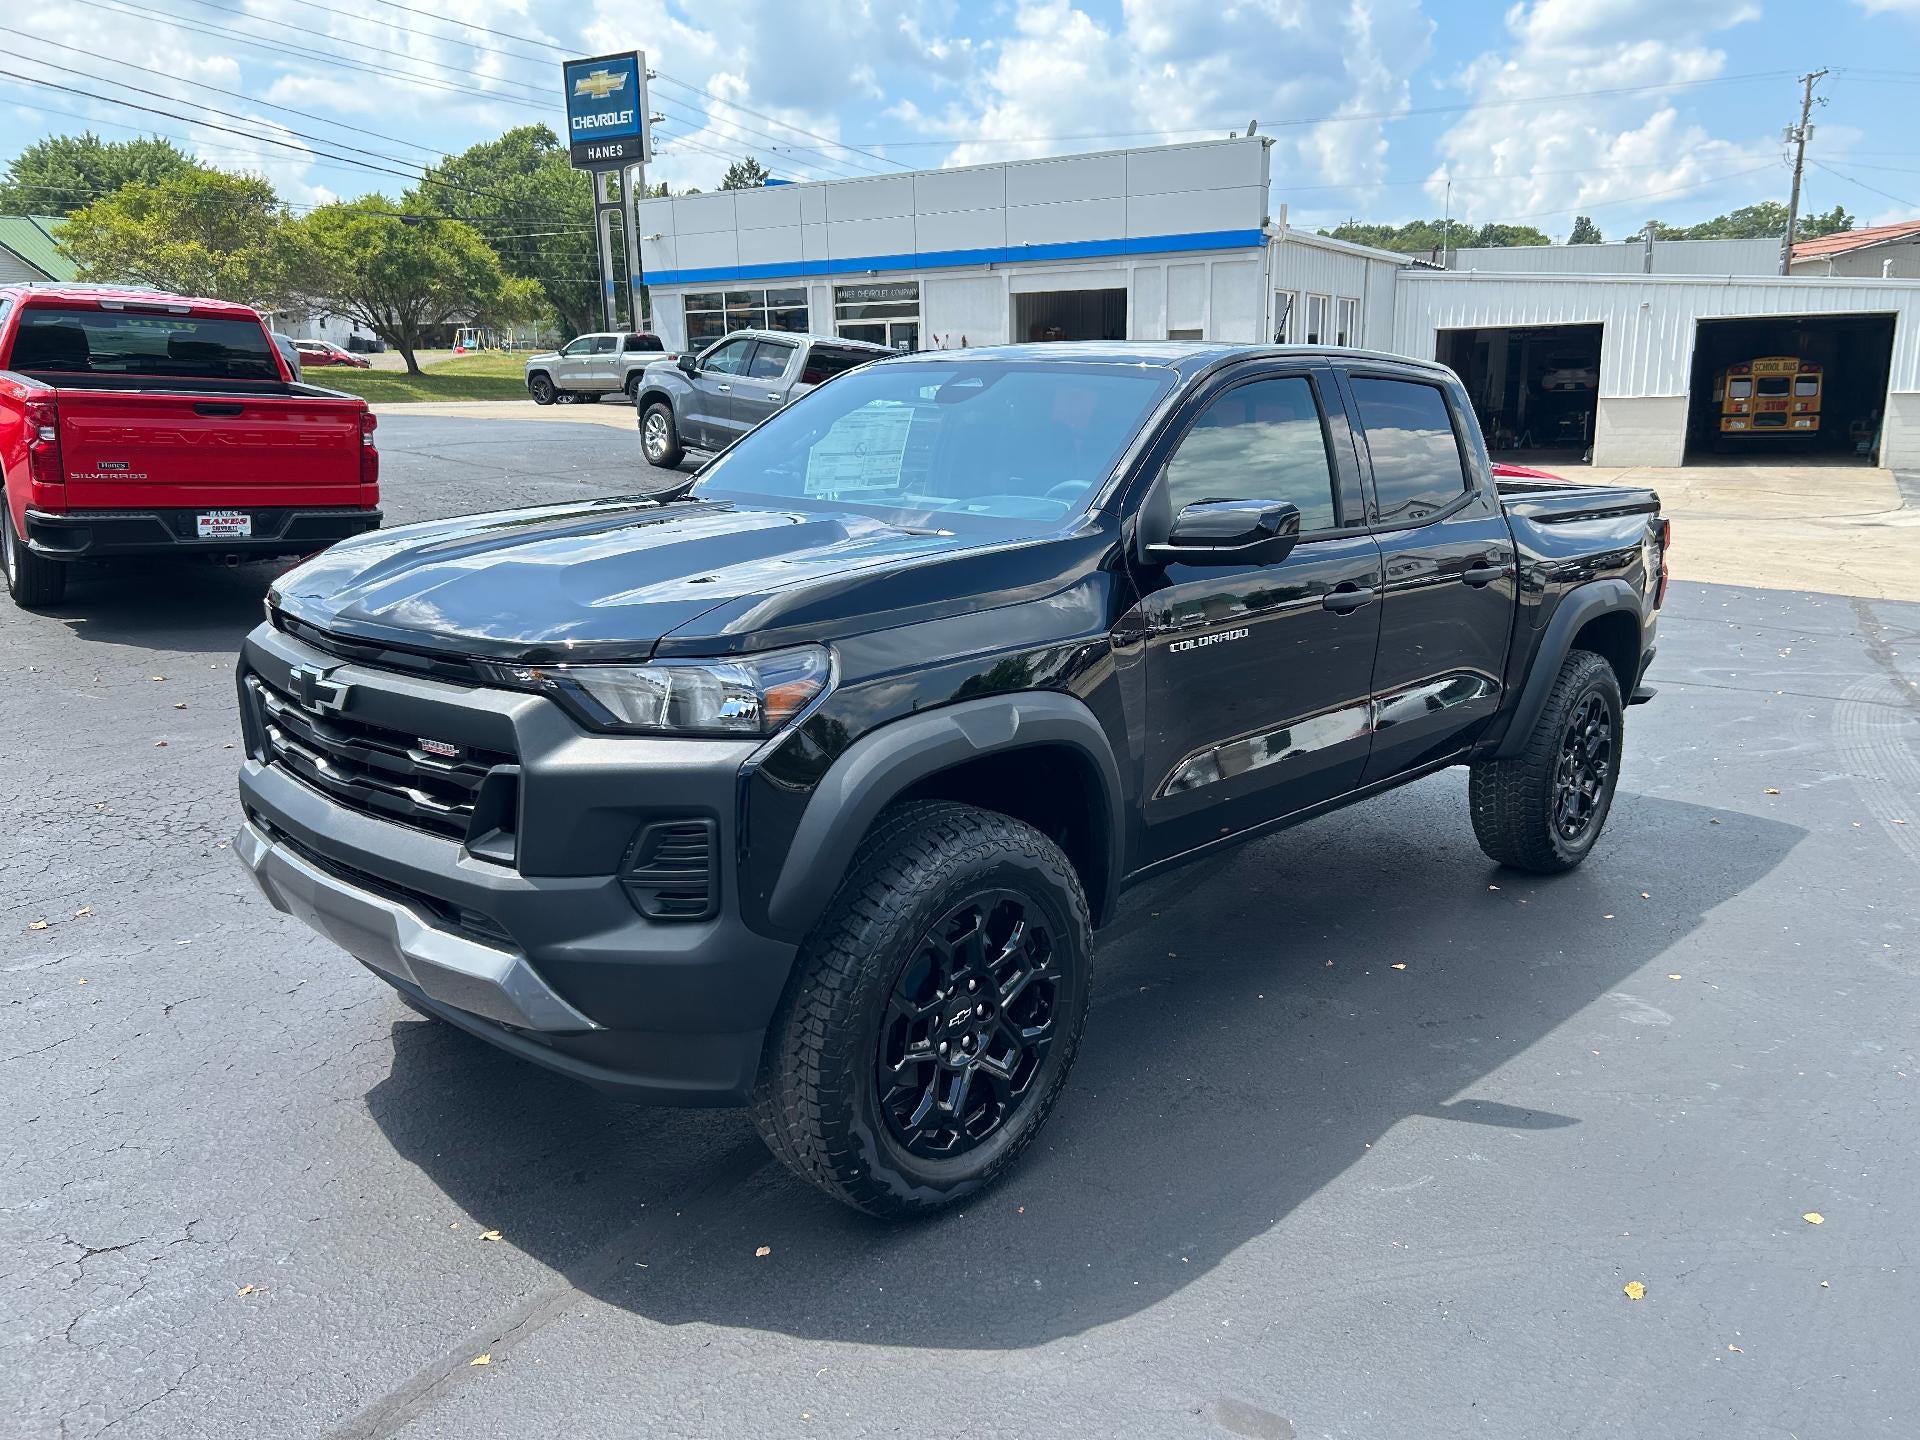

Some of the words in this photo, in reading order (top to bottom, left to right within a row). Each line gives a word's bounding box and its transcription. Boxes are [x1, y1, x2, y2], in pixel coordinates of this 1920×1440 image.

[572, 110, 634, 130] CHEVROLET
[588, 145, 624, 159] HANES
[837, 290, 855, 299] HANES
[857, 288, 889, 299] CHEVROLET
[890, 287, 919, 297] COMPANY
[1754, 361, 1780, 373] SCHOOL
[1782, 360, 1798, 372] BUS
[1764, 400, 1789, 411] STOP
[70, 472, 148, 480] SILVERADO
[200, 517, 248, 526] HANES
[1169, 628, 1249, 653] COLORADO
